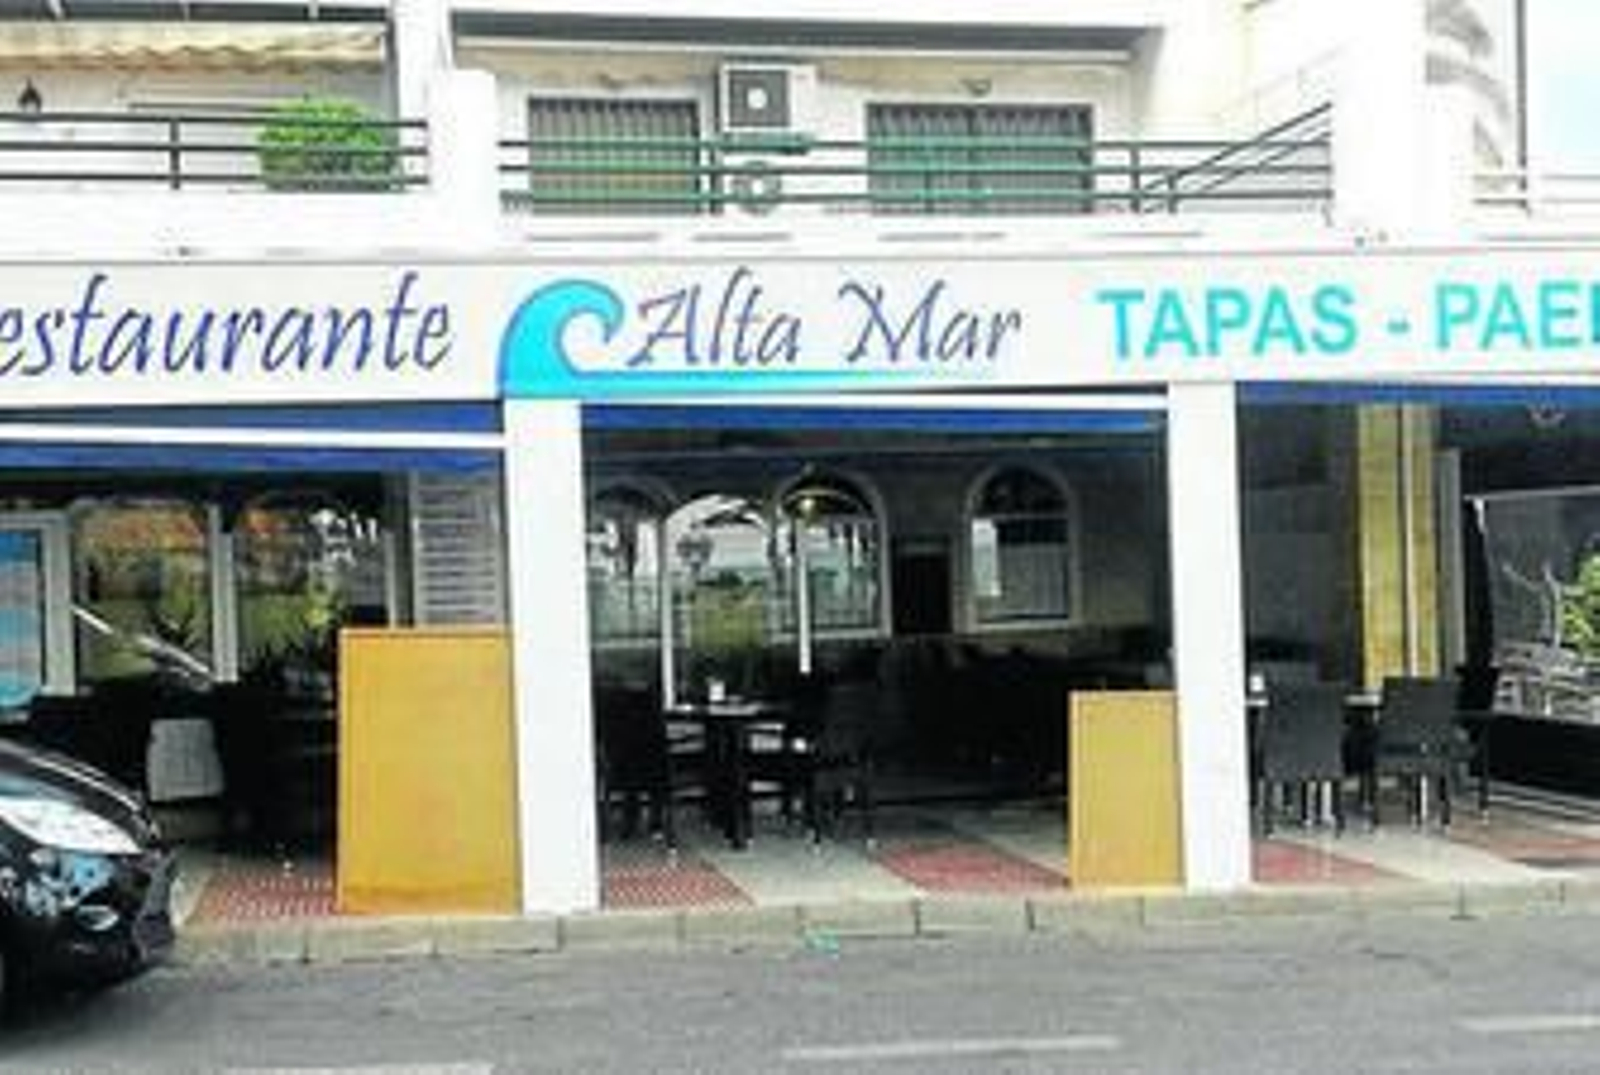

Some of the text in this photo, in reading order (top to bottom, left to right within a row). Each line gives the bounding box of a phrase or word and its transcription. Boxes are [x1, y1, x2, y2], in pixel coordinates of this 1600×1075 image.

[0, 266, 1022, 376] estaurante Alta Mar
[1096, 284, 1358, 360] TAPAS
[1434, 280, 1600, 350] PAE
